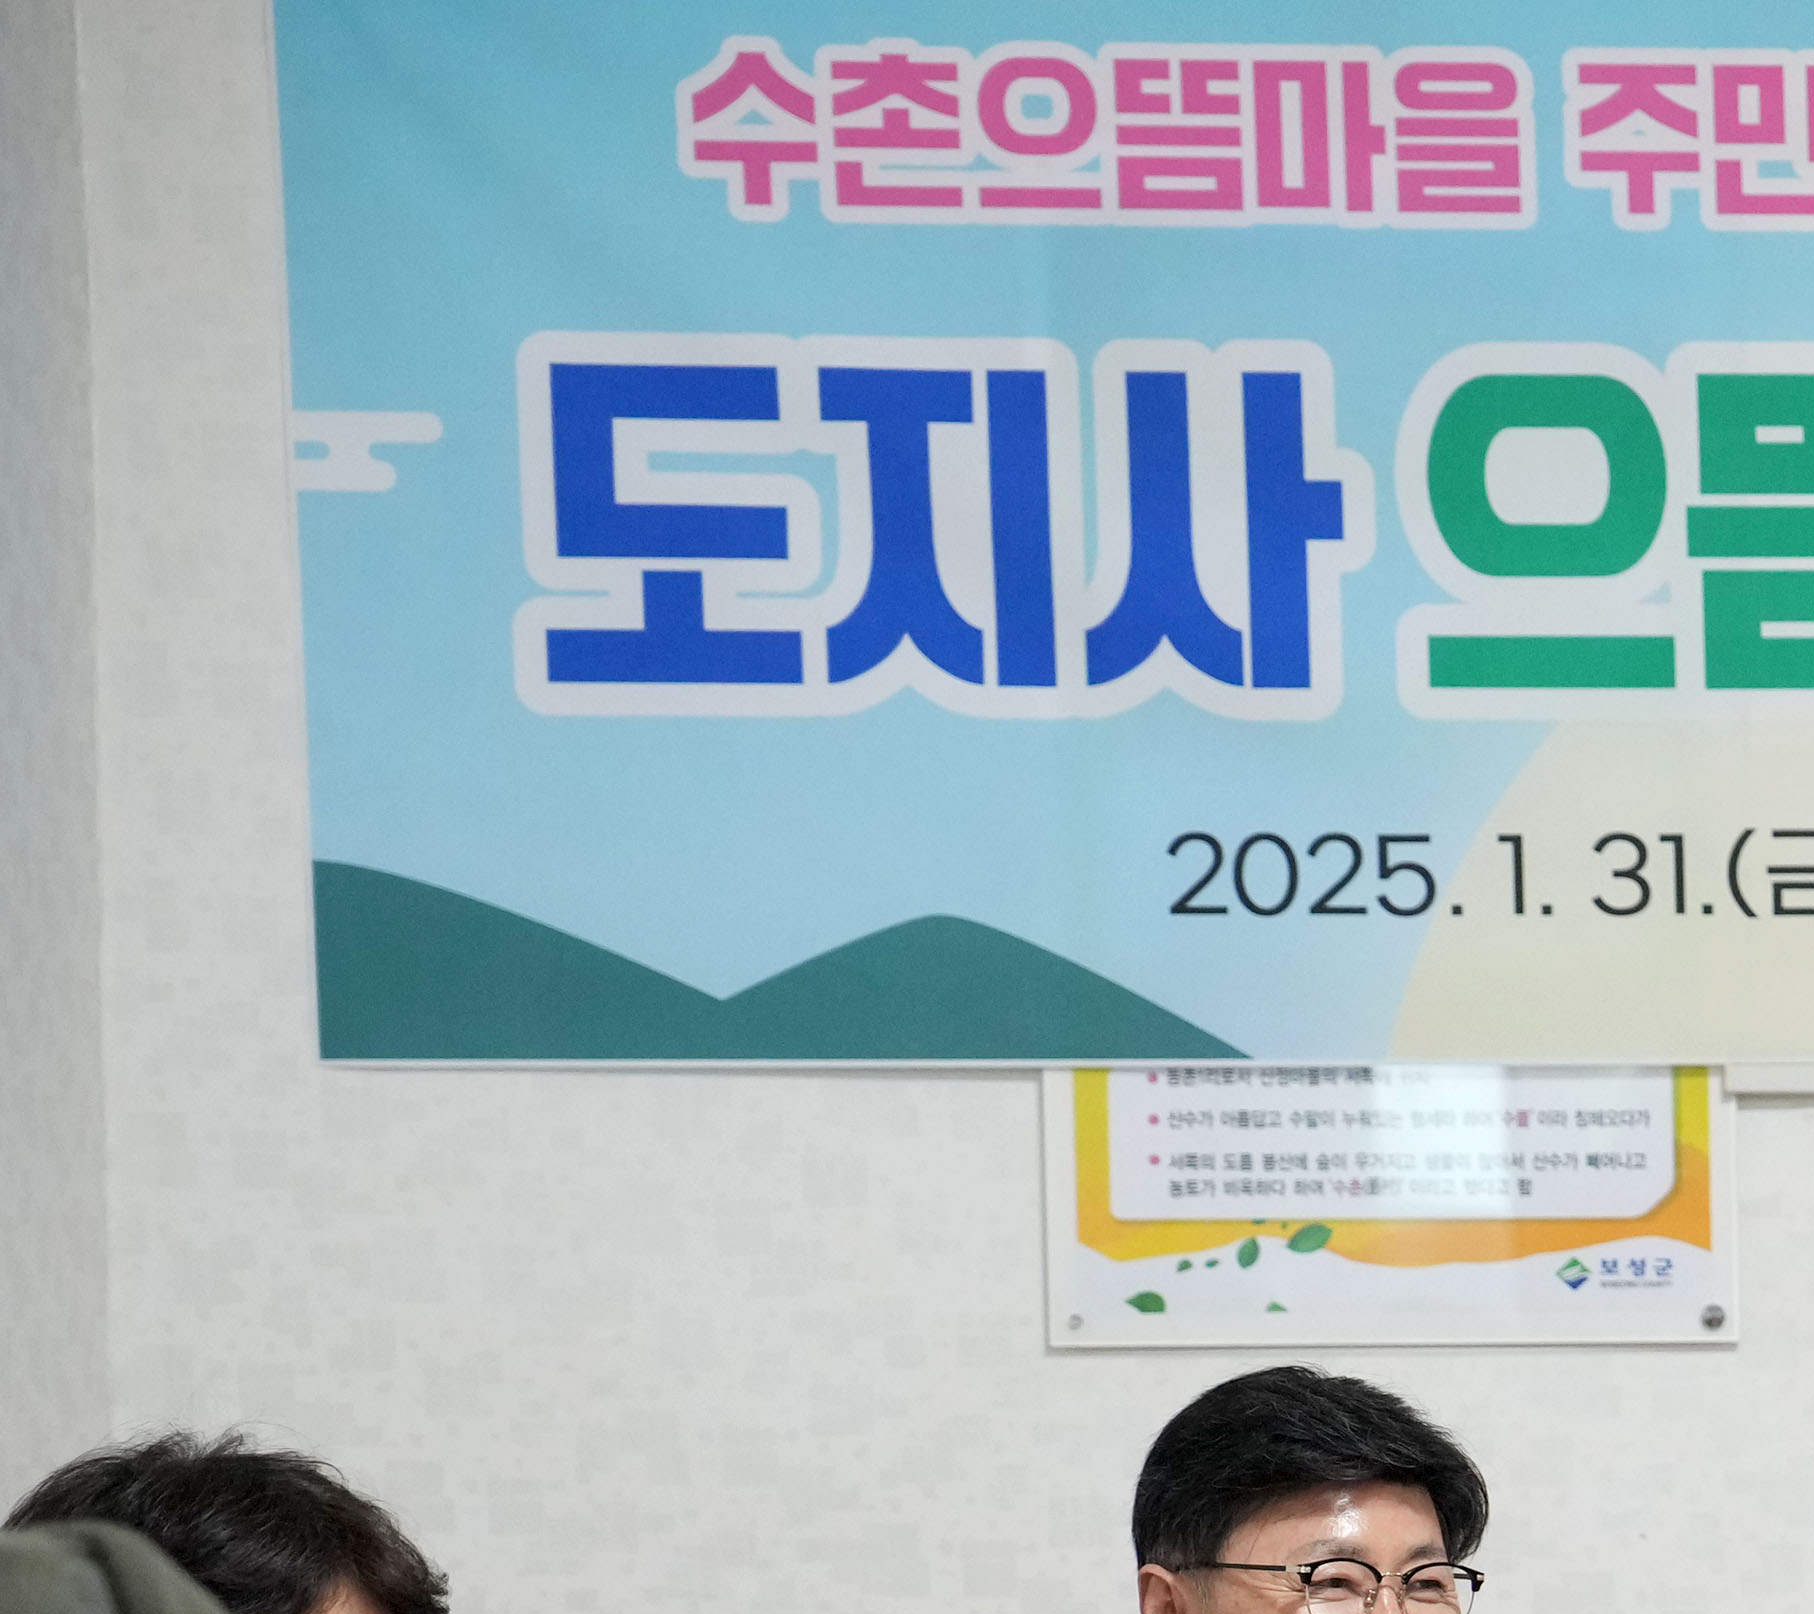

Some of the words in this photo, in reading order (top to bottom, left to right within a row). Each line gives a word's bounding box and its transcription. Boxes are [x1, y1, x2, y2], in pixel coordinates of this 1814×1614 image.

[689, 49, 1525, 216] 수촌으뜸마을
[545, 362, 1345, 690] 도지사
[1166, 831, 1464, 918] 2025.
[1496, 833, 1554, 916] 1.
[1599, 1257, 1673, 1277] 보성군
